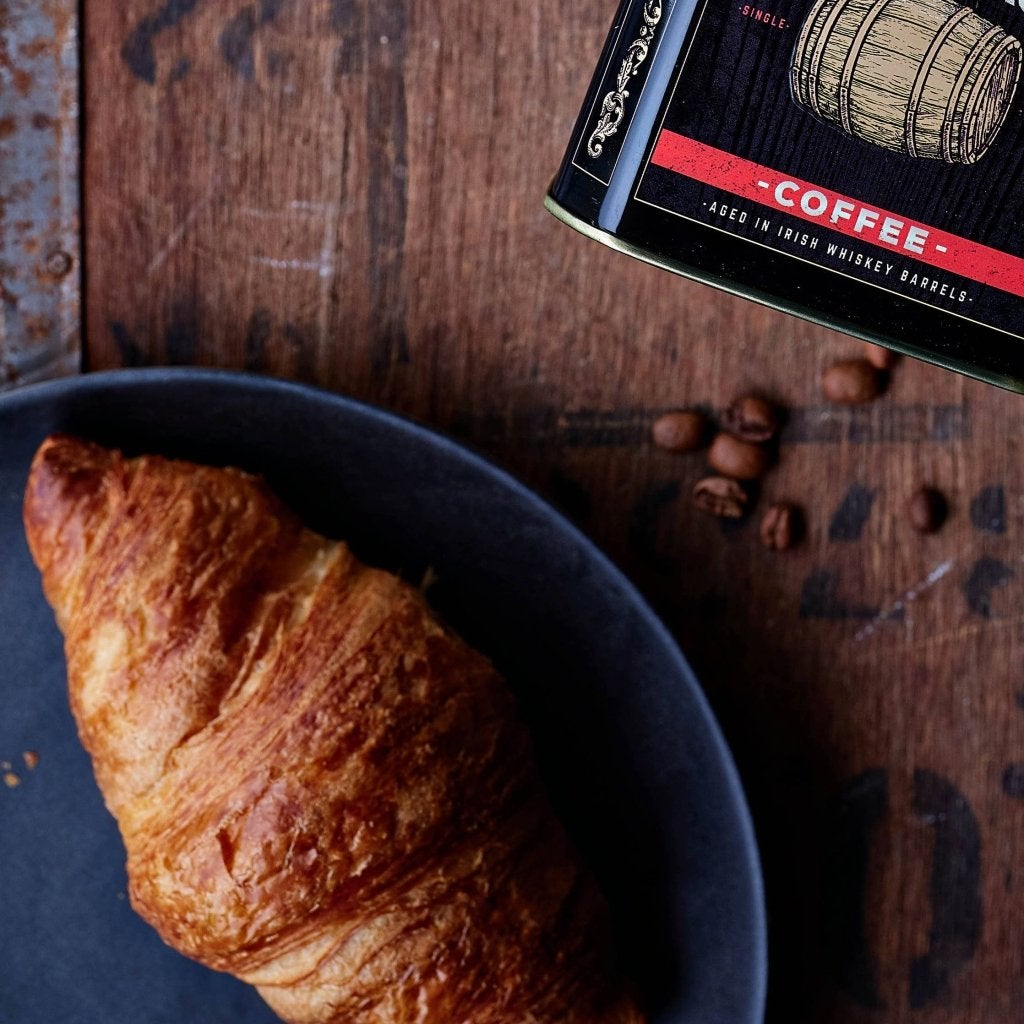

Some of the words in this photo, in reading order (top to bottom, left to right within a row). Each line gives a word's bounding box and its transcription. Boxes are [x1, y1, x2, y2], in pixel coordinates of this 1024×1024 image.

[754, 217, 770, 232] IN
[778, 225, 819, 250] IRISH
[826, 243, 894, 276] WHISKEY
